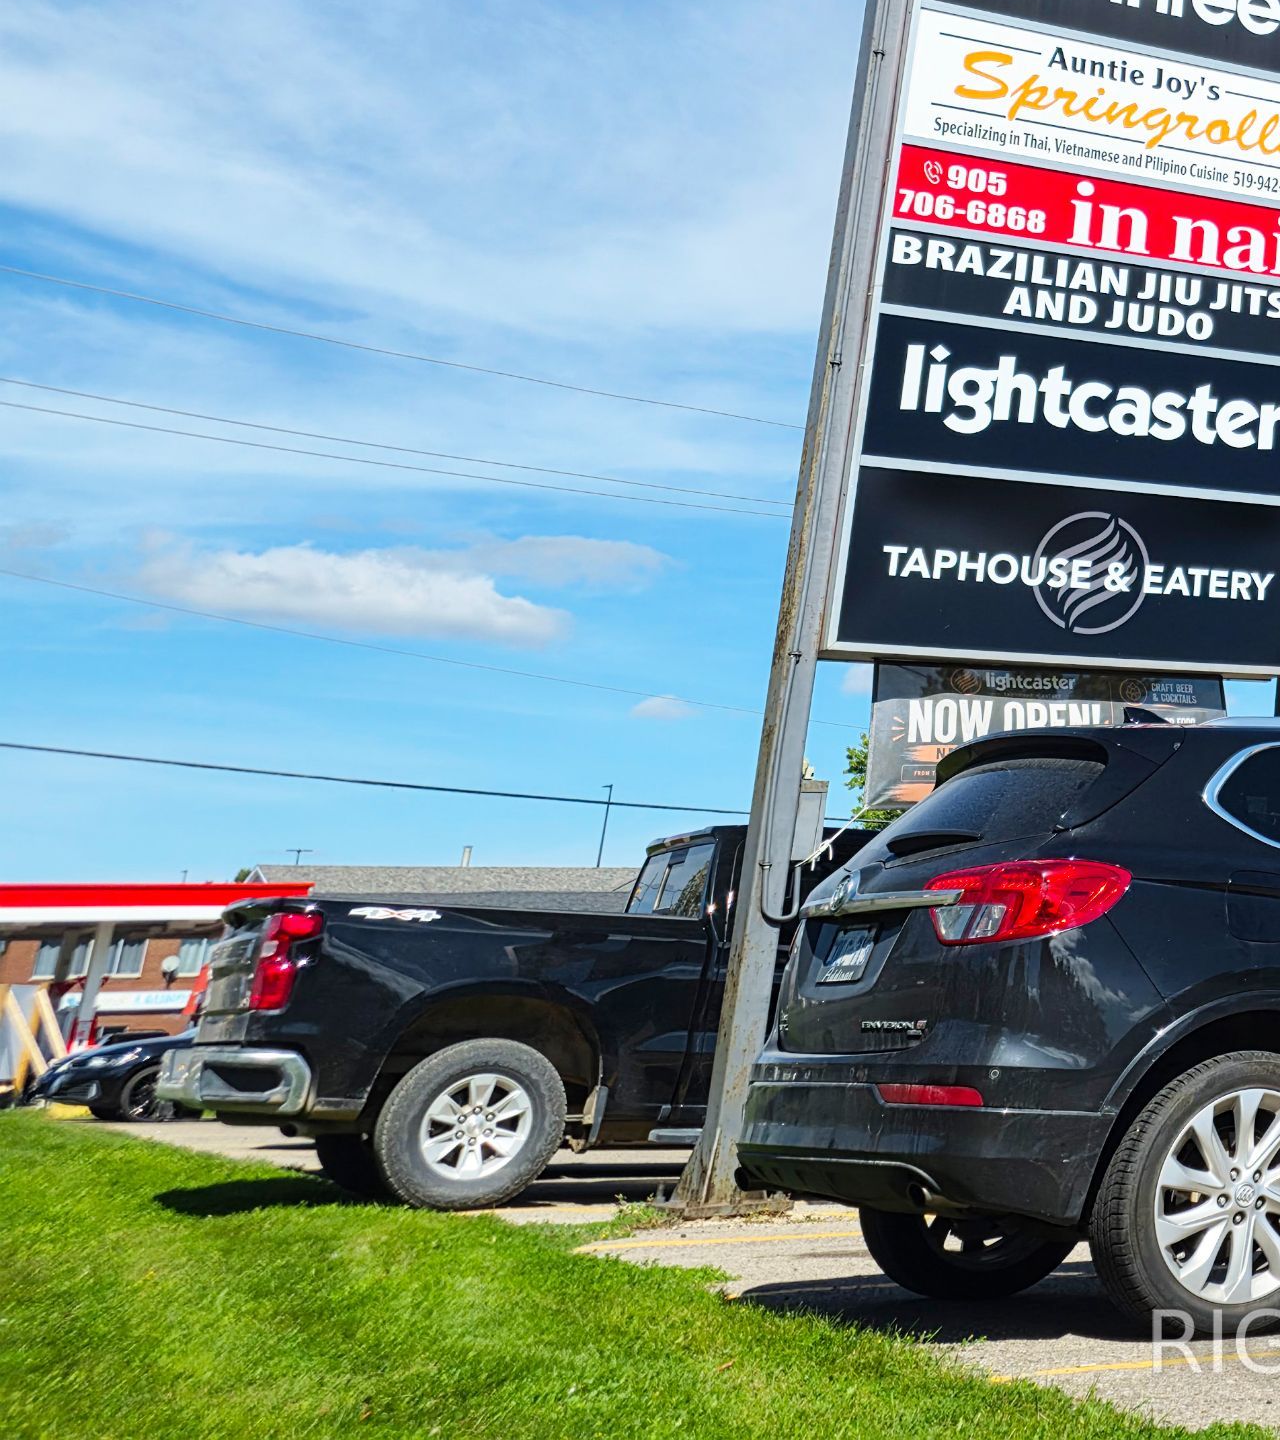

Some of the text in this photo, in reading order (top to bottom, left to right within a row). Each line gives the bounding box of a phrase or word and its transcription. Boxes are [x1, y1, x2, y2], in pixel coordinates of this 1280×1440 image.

[1048, 47, 1221, 101] Auntie Joy's
[933, 116, 1006, 147] Specializing
[1009, 132, 1020, 147] in
[1023, 133, 1052, 154] Thai,
[1054, 139, 1120, 164] Vietnamese
[1122, 151, 1143, 169] and
[1145, 155, 1188, 181] Pilipino
[1189, 163, 1229, 184] Cuisine
[947, 164, 1007, 197] 905
[898, 188, 1046, 235] 706-6868
[1066, 180, 1150, 256] in
[891, 234, 1129, 299] BRAZILIAN
[1138, 271, 1201, 307] JIU
[1003, 287, 1214, 341] AND JUDO
[883, 545, 1275, 602] TAPHOUSE & EATERY
[985, 671, 1076, 691] lightcaster
[1151, 682, 1193, 694] CRAFT BEER
[1161, 693, 1198, 704] COCKTAILS
[907, 698, 993, 743] NOW
[861, 1020, 914, 1029] ENVISION
